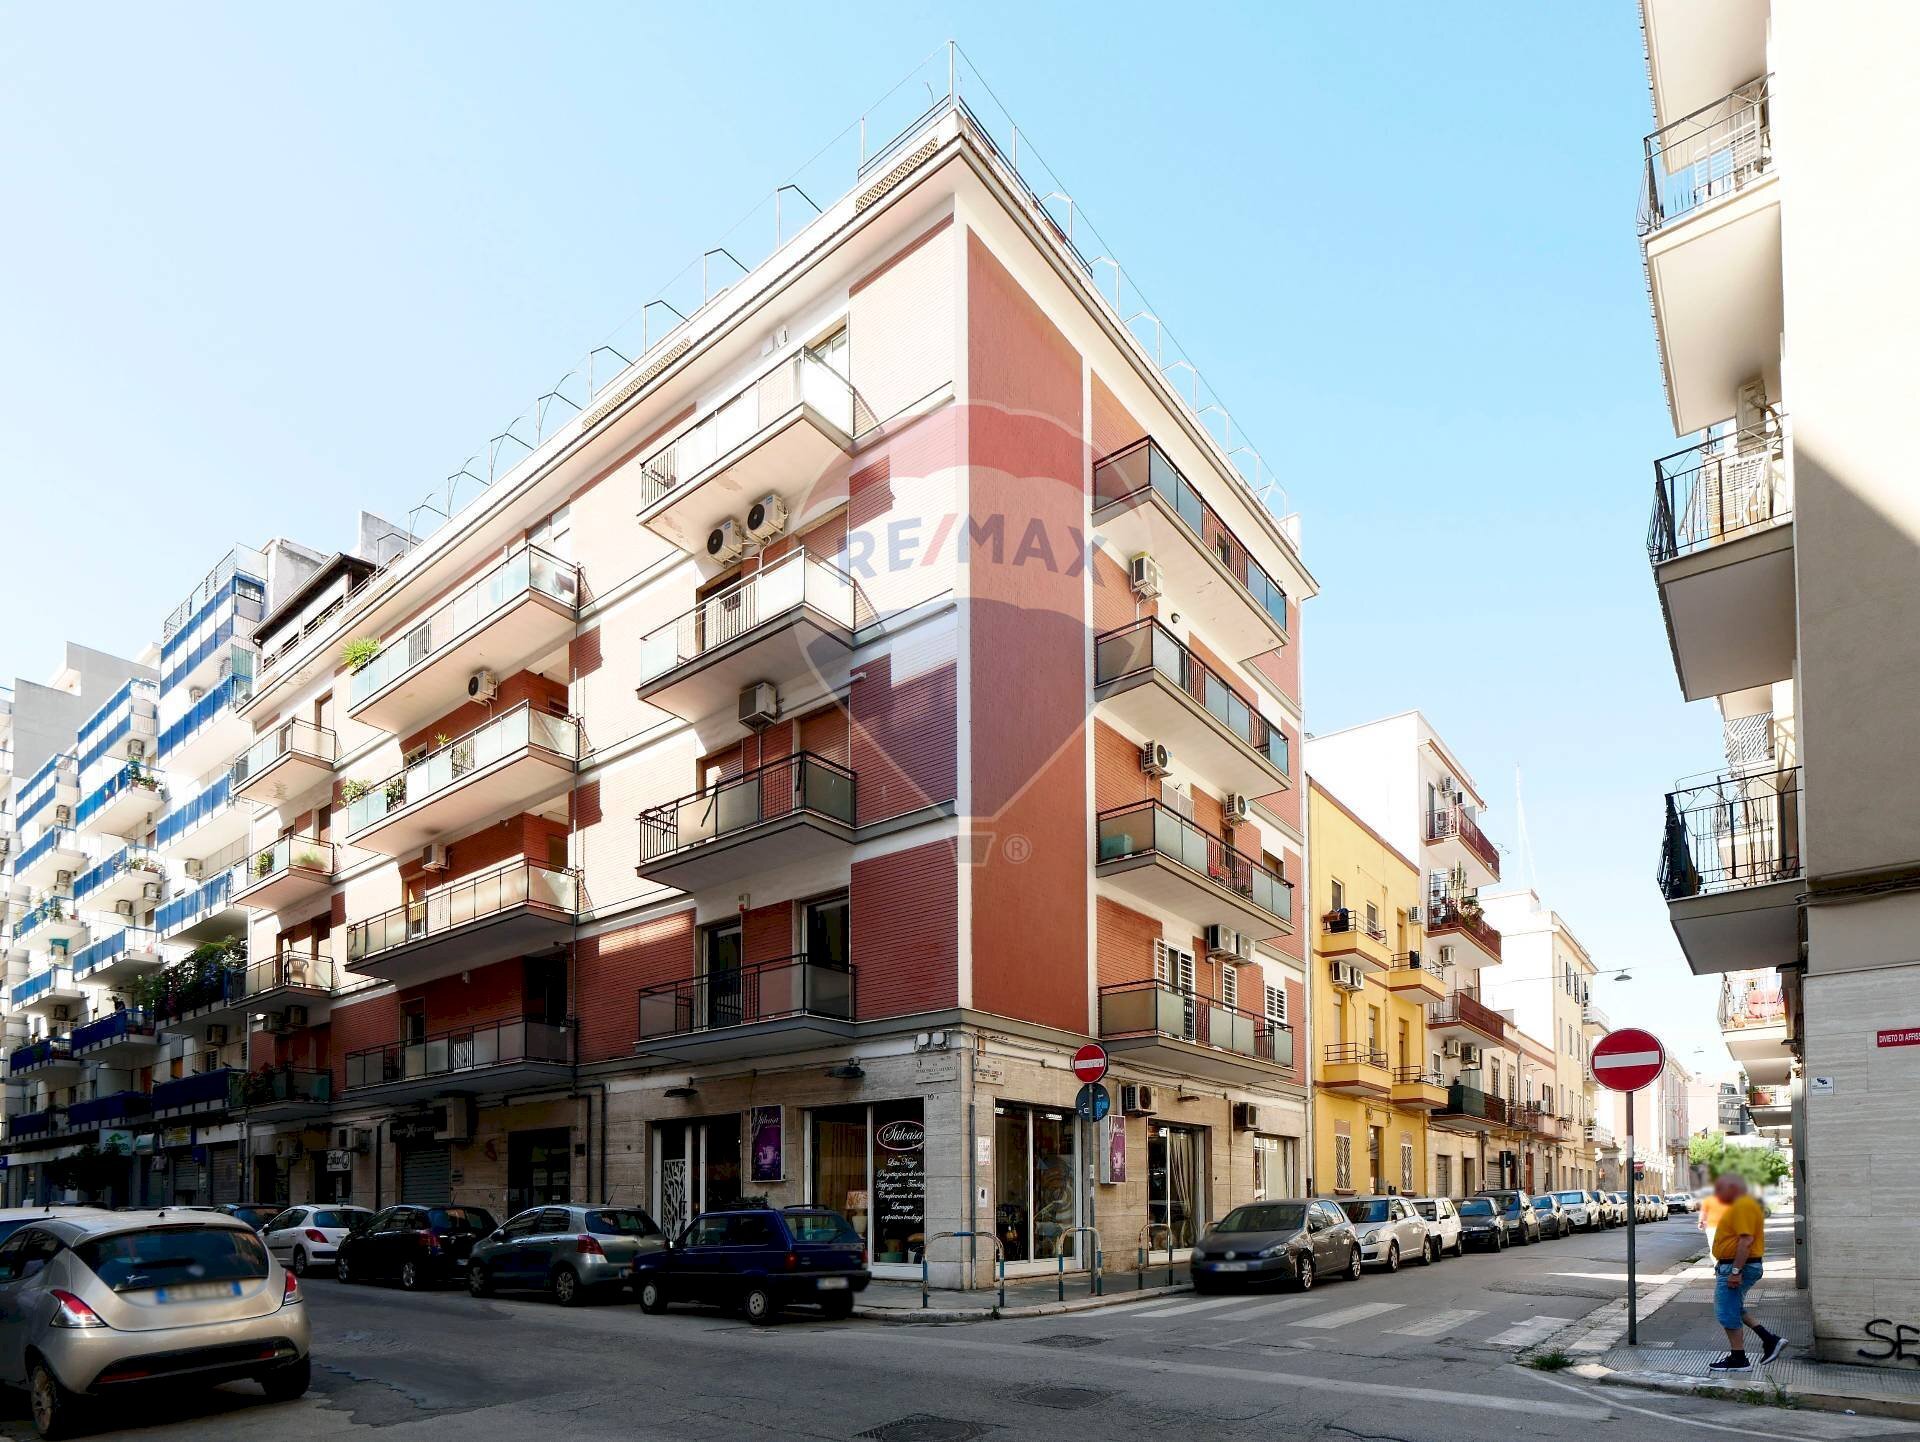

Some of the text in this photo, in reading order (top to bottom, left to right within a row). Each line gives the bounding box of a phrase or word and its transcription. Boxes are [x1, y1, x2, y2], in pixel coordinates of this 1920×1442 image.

[1879, 1032, 1920, 1043] DIVIETO DI AFFIS
